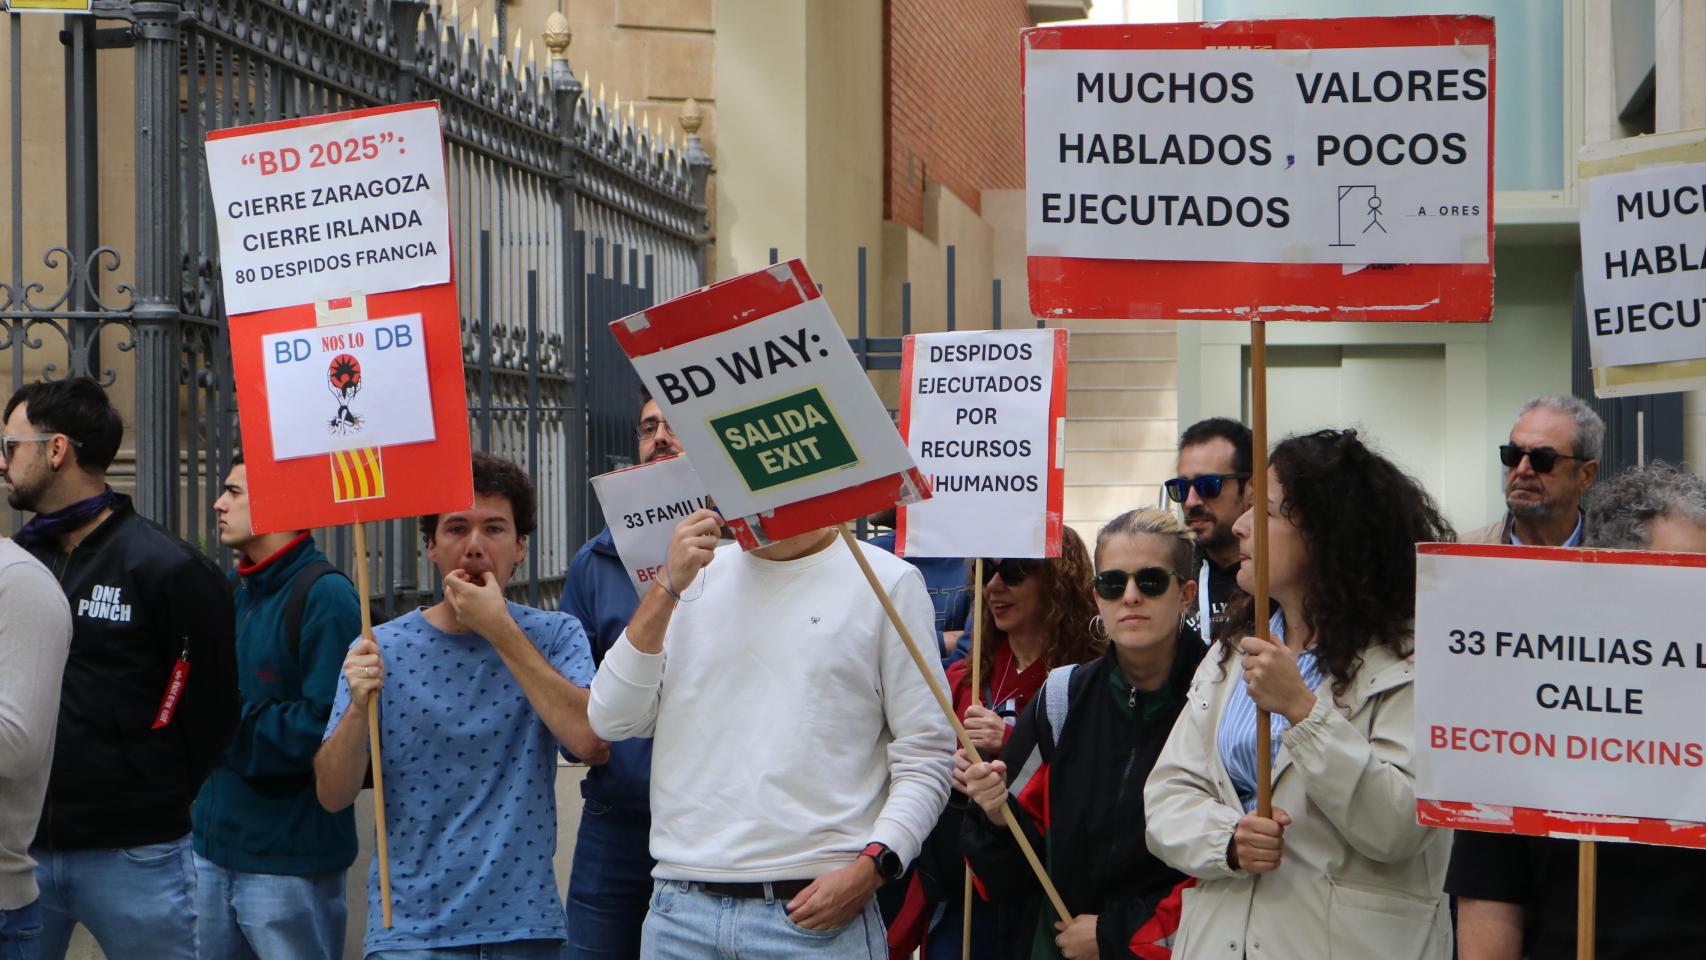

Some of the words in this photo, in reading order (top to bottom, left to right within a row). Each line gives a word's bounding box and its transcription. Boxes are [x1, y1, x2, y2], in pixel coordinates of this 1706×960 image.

[1077, 72, 1254, 104] MUCHOS
[1296, 68, 1487, 104] VALORES
[1317, 132, 1467, 167] POCOS
[228, 190, 306, 219] CIERRE
[312, 173, 430, 207] ZARAGOZA
[1042, 193, 1290, 229] EJECUTADOS
[1617, 184, 1706, 222] MUC
[243, 223, 321, 252] CIERRE
[326, 209, 422, 239] IRLANDA
[235, 268, 256, 285] 80
[261, 253, 352, 281] DESPIDOS
[355, 240, 437, 265] FRANCIA
[275, 338, 311, 364] BD
[321, 334, 345, 352] NOS
[349, 332, 364, 349] LO
[375, 324, 413, 350] DB
[930, 343, 1032, 363] DESPIDOS
[656, 364, 716, 405] BD
[716, 328, 828, 385] WAY:
[918, 375, 1042, 394] EJECUTADOS
[725, 403, 828, 451] SALIDA
[956, 408, 997, 425] POR
[757, 436, 822, 474] EXIT
[921, 440, 1032, 458] RECURSOS
[623, 512, 644, 529] 33
[77, 598, 131, 622] PUNCH
[91, 584, 121, 604] ONE
[1448, 629, 1486, 656] 33
[1496, 631, 1653, 666] FAMILIAS
[1661, 641, 1686, 668] A
[1536, 683, 1644, 715] CALLE
[1430, 725, 1556, 758] BECTON
[1566, 735, 1704, 768] DICKINS
